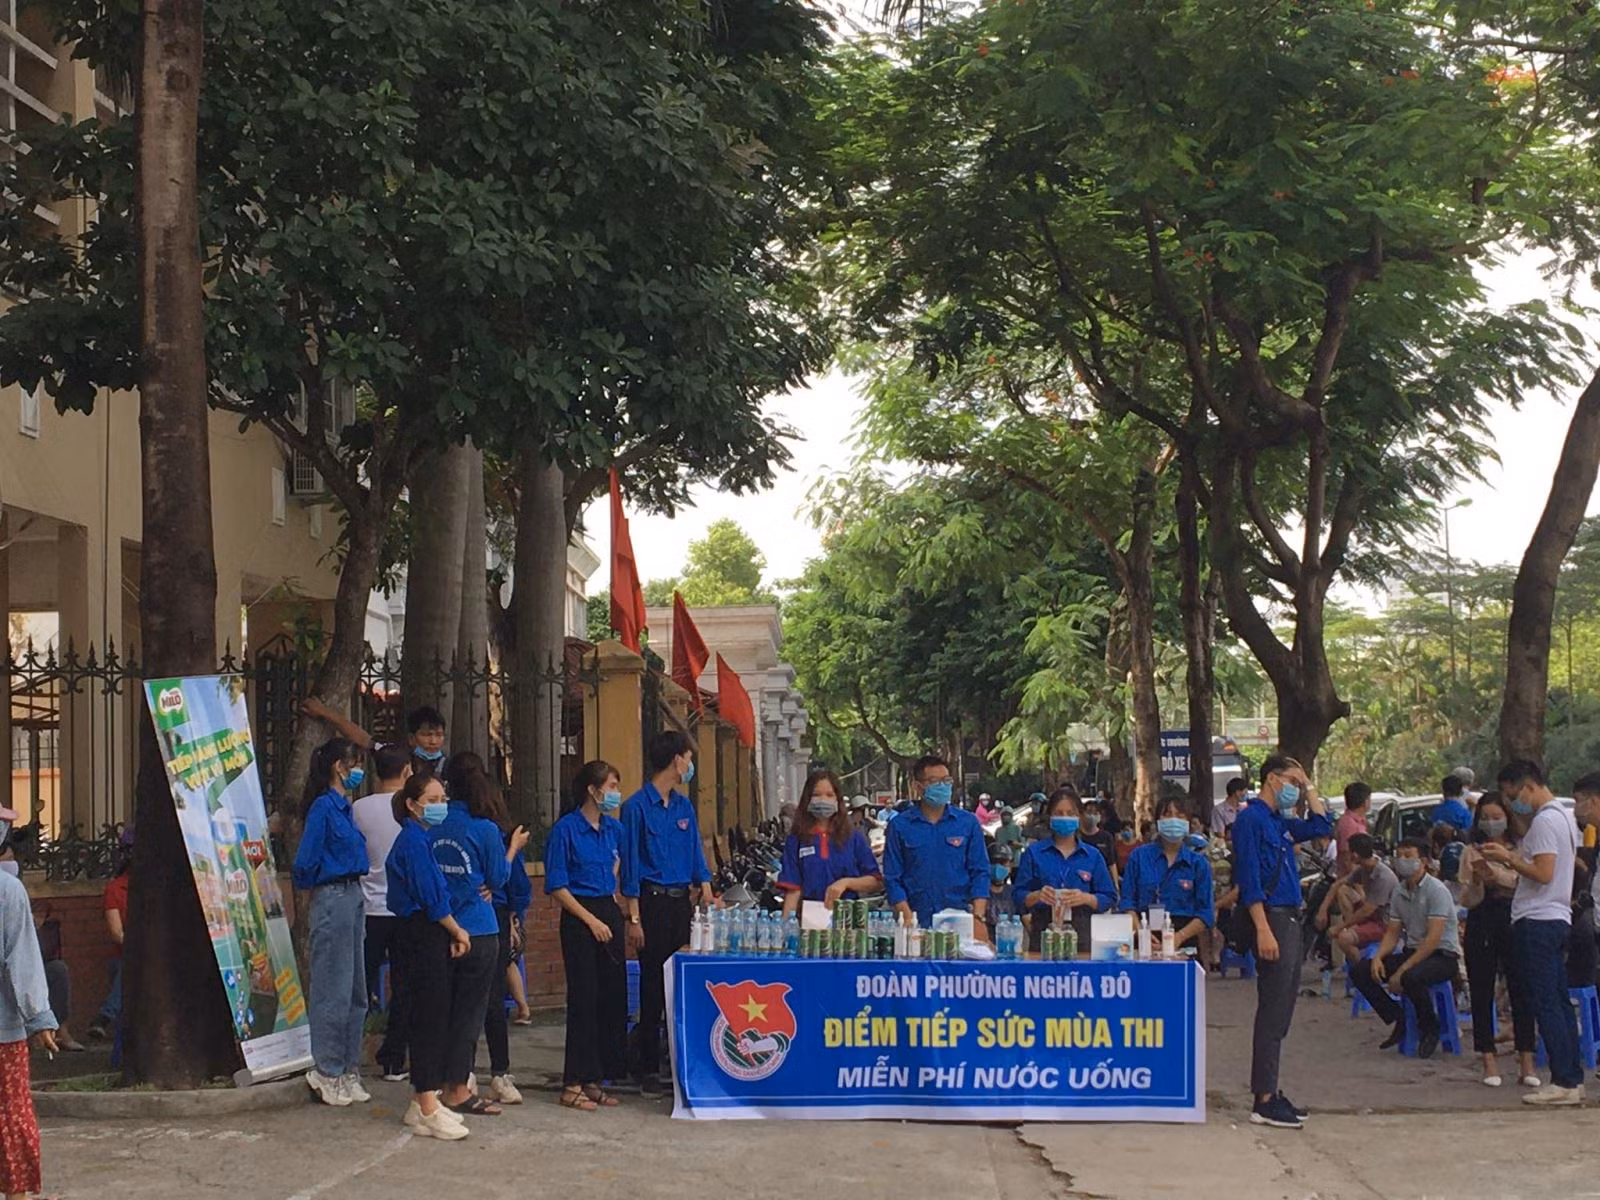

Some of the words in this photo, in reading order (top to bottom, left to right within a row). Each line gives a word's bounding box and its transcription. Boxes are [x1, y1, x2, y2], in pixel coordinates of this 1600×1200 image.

[856, 970, 918, 998] ĐOÀN
[925, 970, 1016, 999] PHƯỜNG
[1024, 971, 1094, 999] NGHĨA
[1100, 971, 1131, 999] ĐÔ
[823, 1005, 897, 1048] ĐIỂM
[905, 1007, 968, 1048] TIẾP
[977, 1009, 1036, 1048] SỨC
[1045, 1011, 1113, 1048] MÙA
[1120, 1017, 1164, 1048] THI
[837, 1055, 909, 1088] MIỄN
[918, 1061, 967, 1089] PHÍ
[973, 1061, 1059, 1089] NƯỚC
[1068, 1058, 1152, 1089] UỐNG
